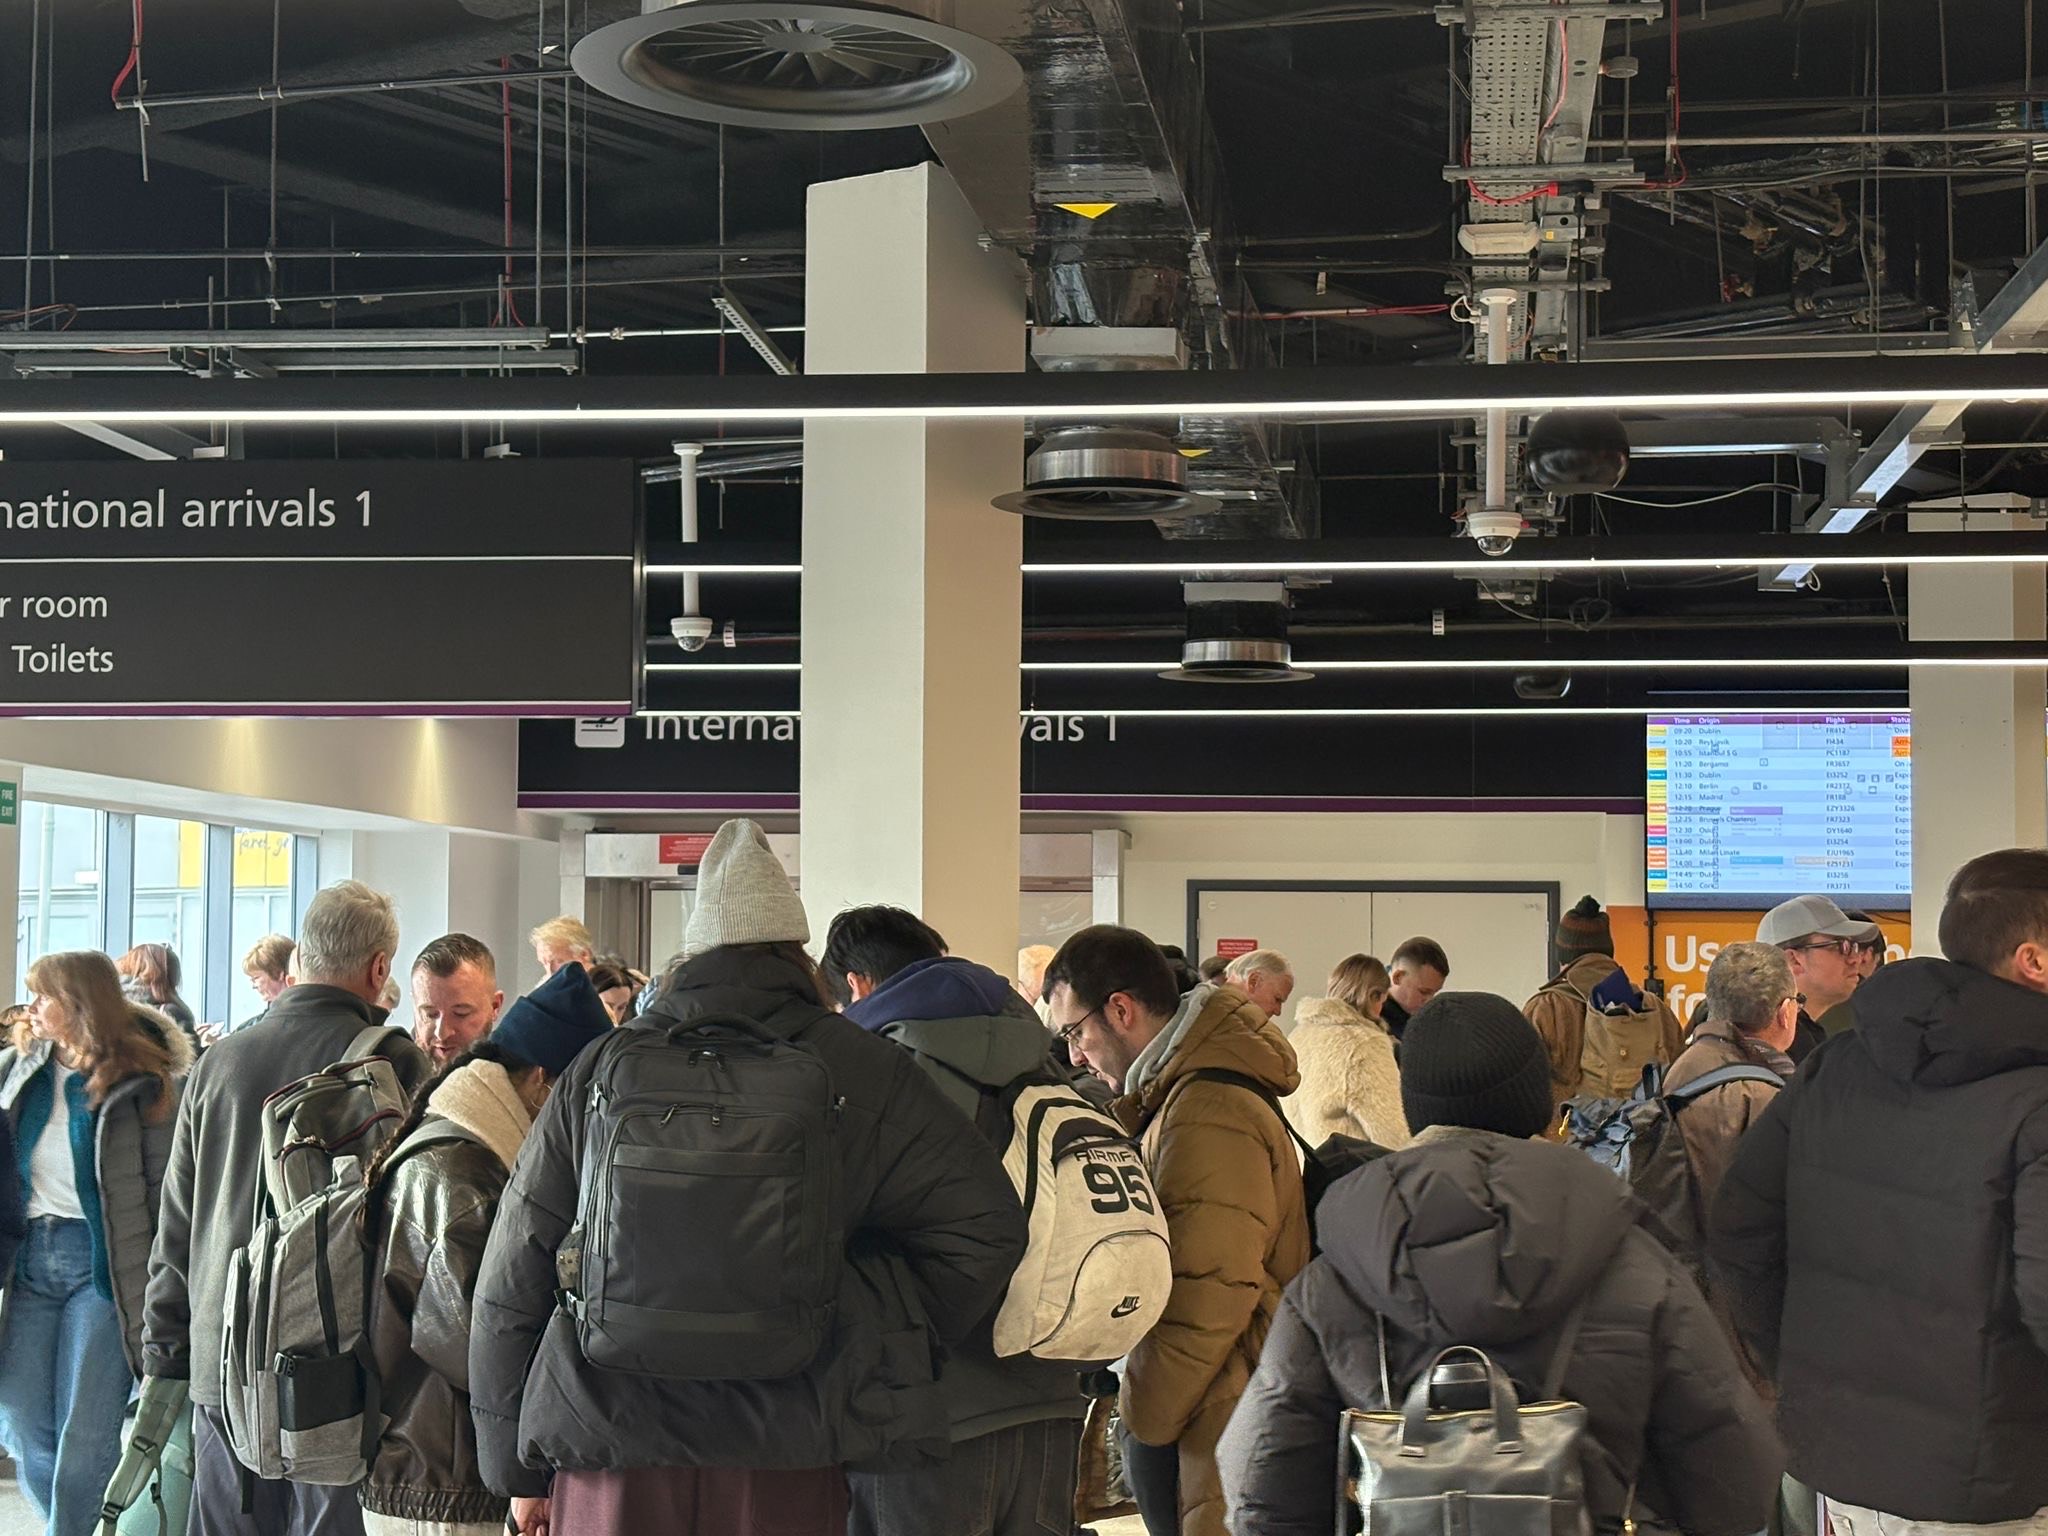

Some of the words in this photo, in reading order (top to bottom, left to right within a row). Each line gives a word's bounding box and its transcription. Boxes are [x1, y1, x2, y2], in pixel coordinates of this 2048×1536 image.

[182, 488, 336, 528] arrivals
[356, 490, 371, 527] 1
[23, 595, 108, 618] room
[11, 643, 114, 673] Toilets
[645, 715, 800, 741] Interna
[1698, 717, 1720, 726] Origin
[1825, 716, 1846, 726] Flight
[1, 789, 14, 800] FIRE
[1698, 793, 1724, 801] Madrid
[1, 806, 14, 816] EXIT
[1082, 1163, 1155, 1216] 95
